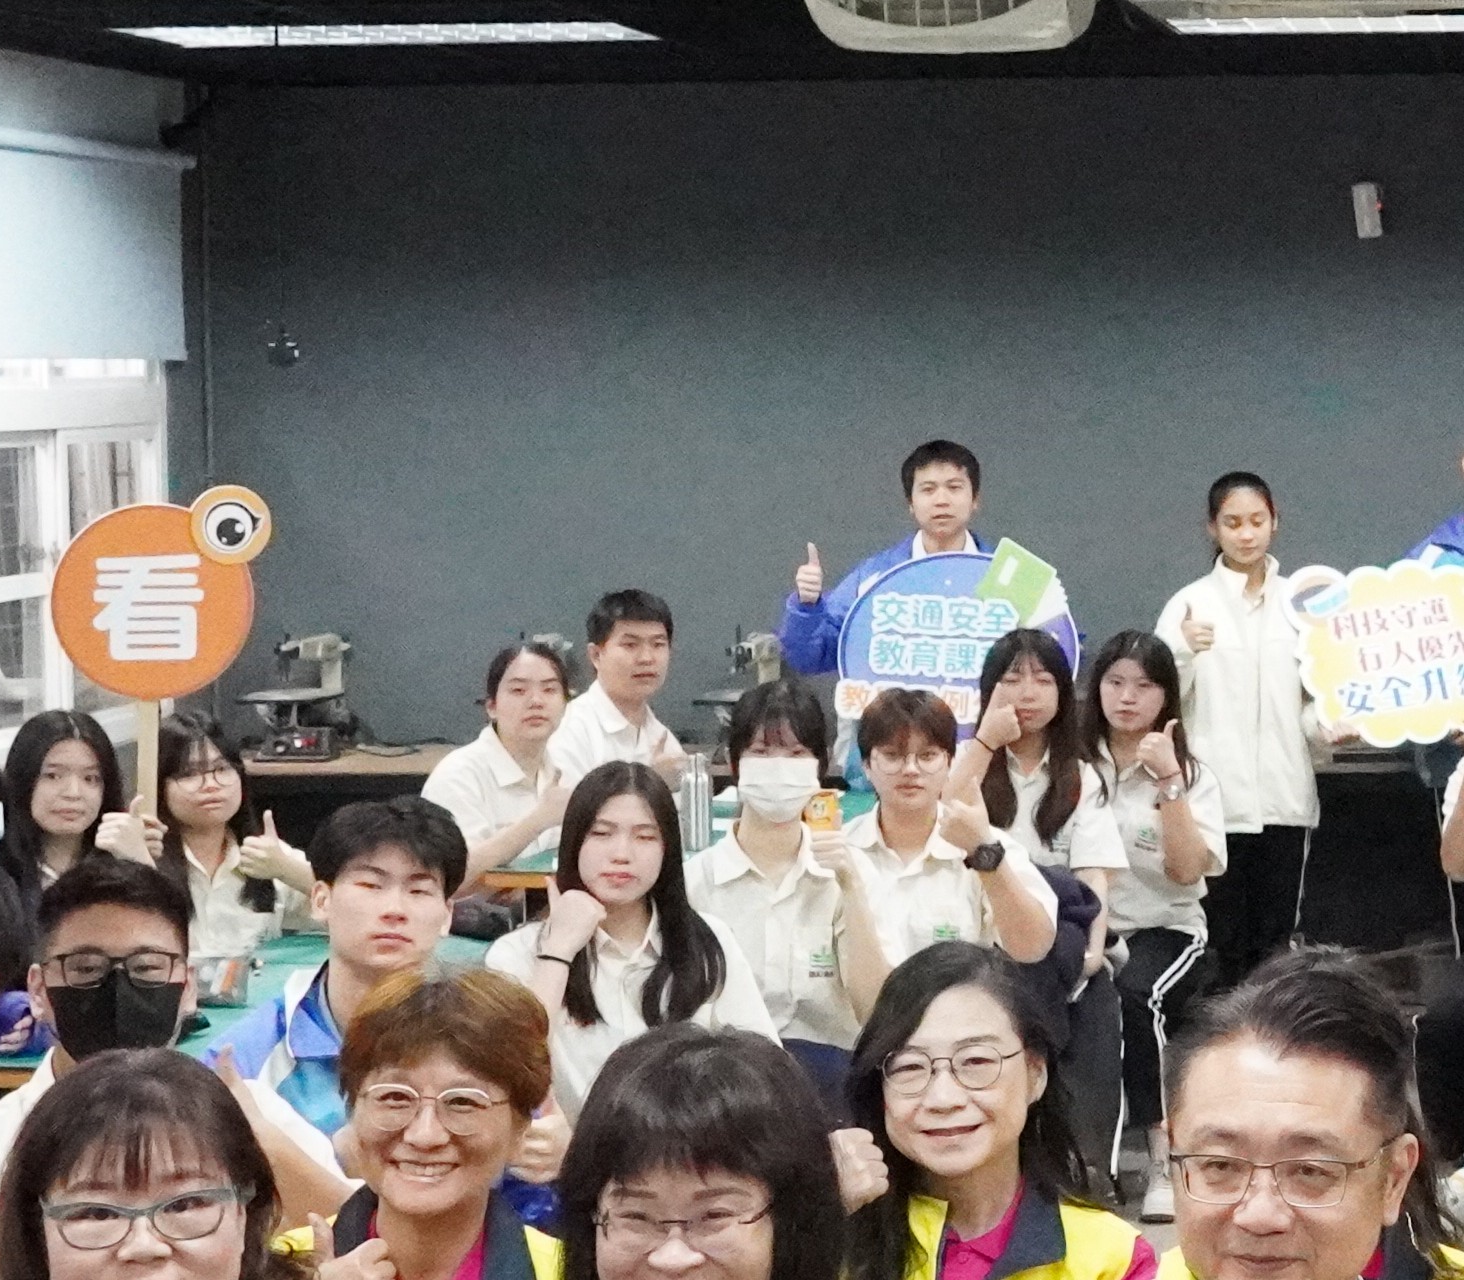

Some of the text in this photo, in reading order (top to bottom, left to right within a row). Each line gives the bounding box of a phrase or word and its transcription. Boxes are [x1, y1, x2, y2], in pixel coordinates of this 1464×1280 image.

[92, 554, 204, 661] 看
[877, 598, 1017, 633] 交通安全
[875, 638, 996, 674] 教育課
